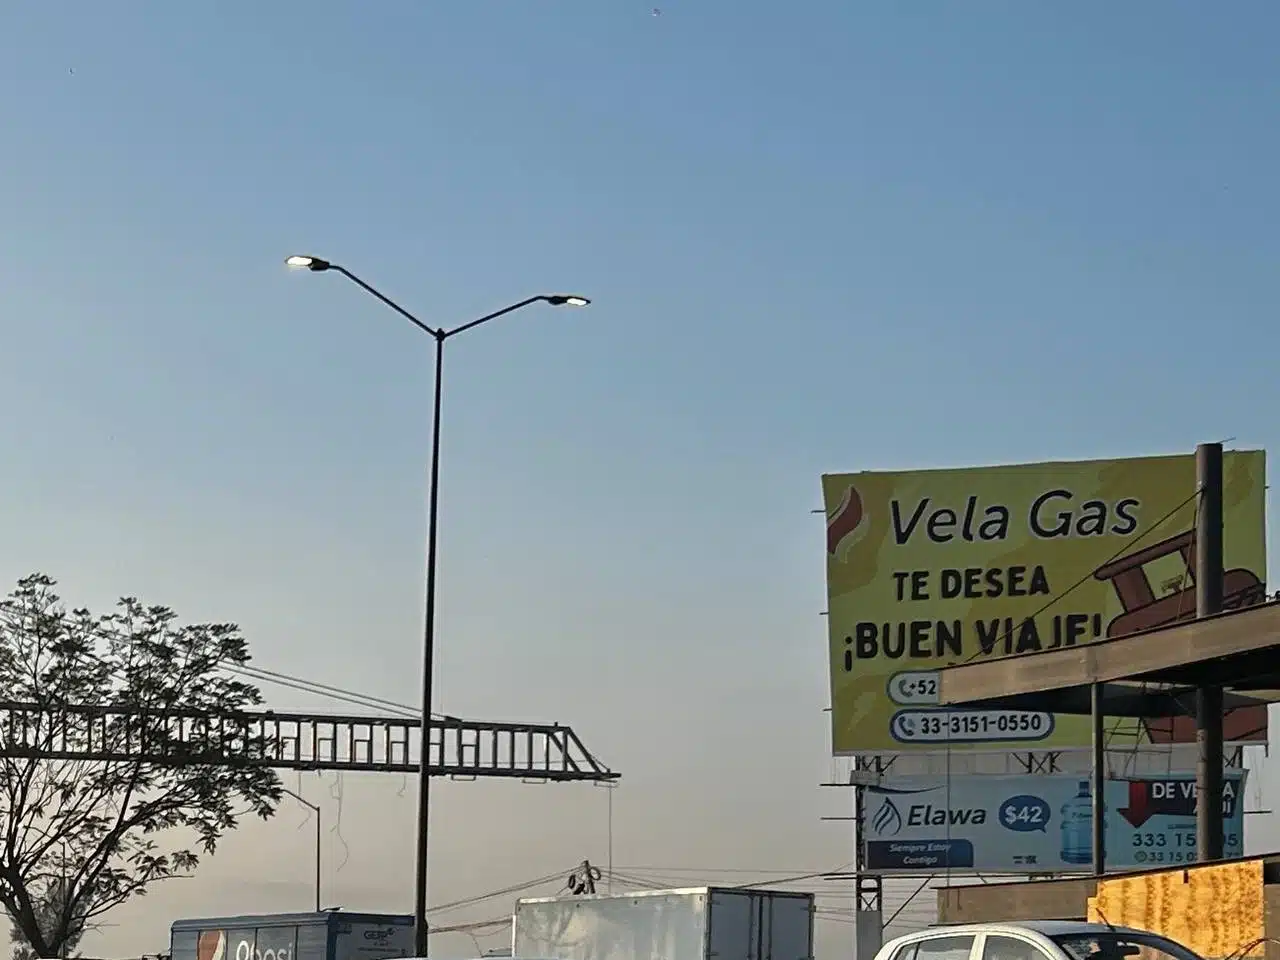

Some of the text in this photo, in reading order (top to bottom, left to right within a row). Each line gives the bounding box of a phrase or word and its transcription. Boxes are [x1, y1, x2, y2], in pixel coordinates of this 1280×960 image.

[891, 489, 1140, 544] Vela Gas
[893, 566, 1050, 601] TE DESEA
[844, 619, 963, 671] ¡BUEN
[921, 714, 1041, 735] 33-3151-0550
[1152, 782, 1176, 799] DE
[907, 804, 986, 826] Elawa
[1004, 804, 1042, 825] $42
[1132, 833, 1167, 847] 333
